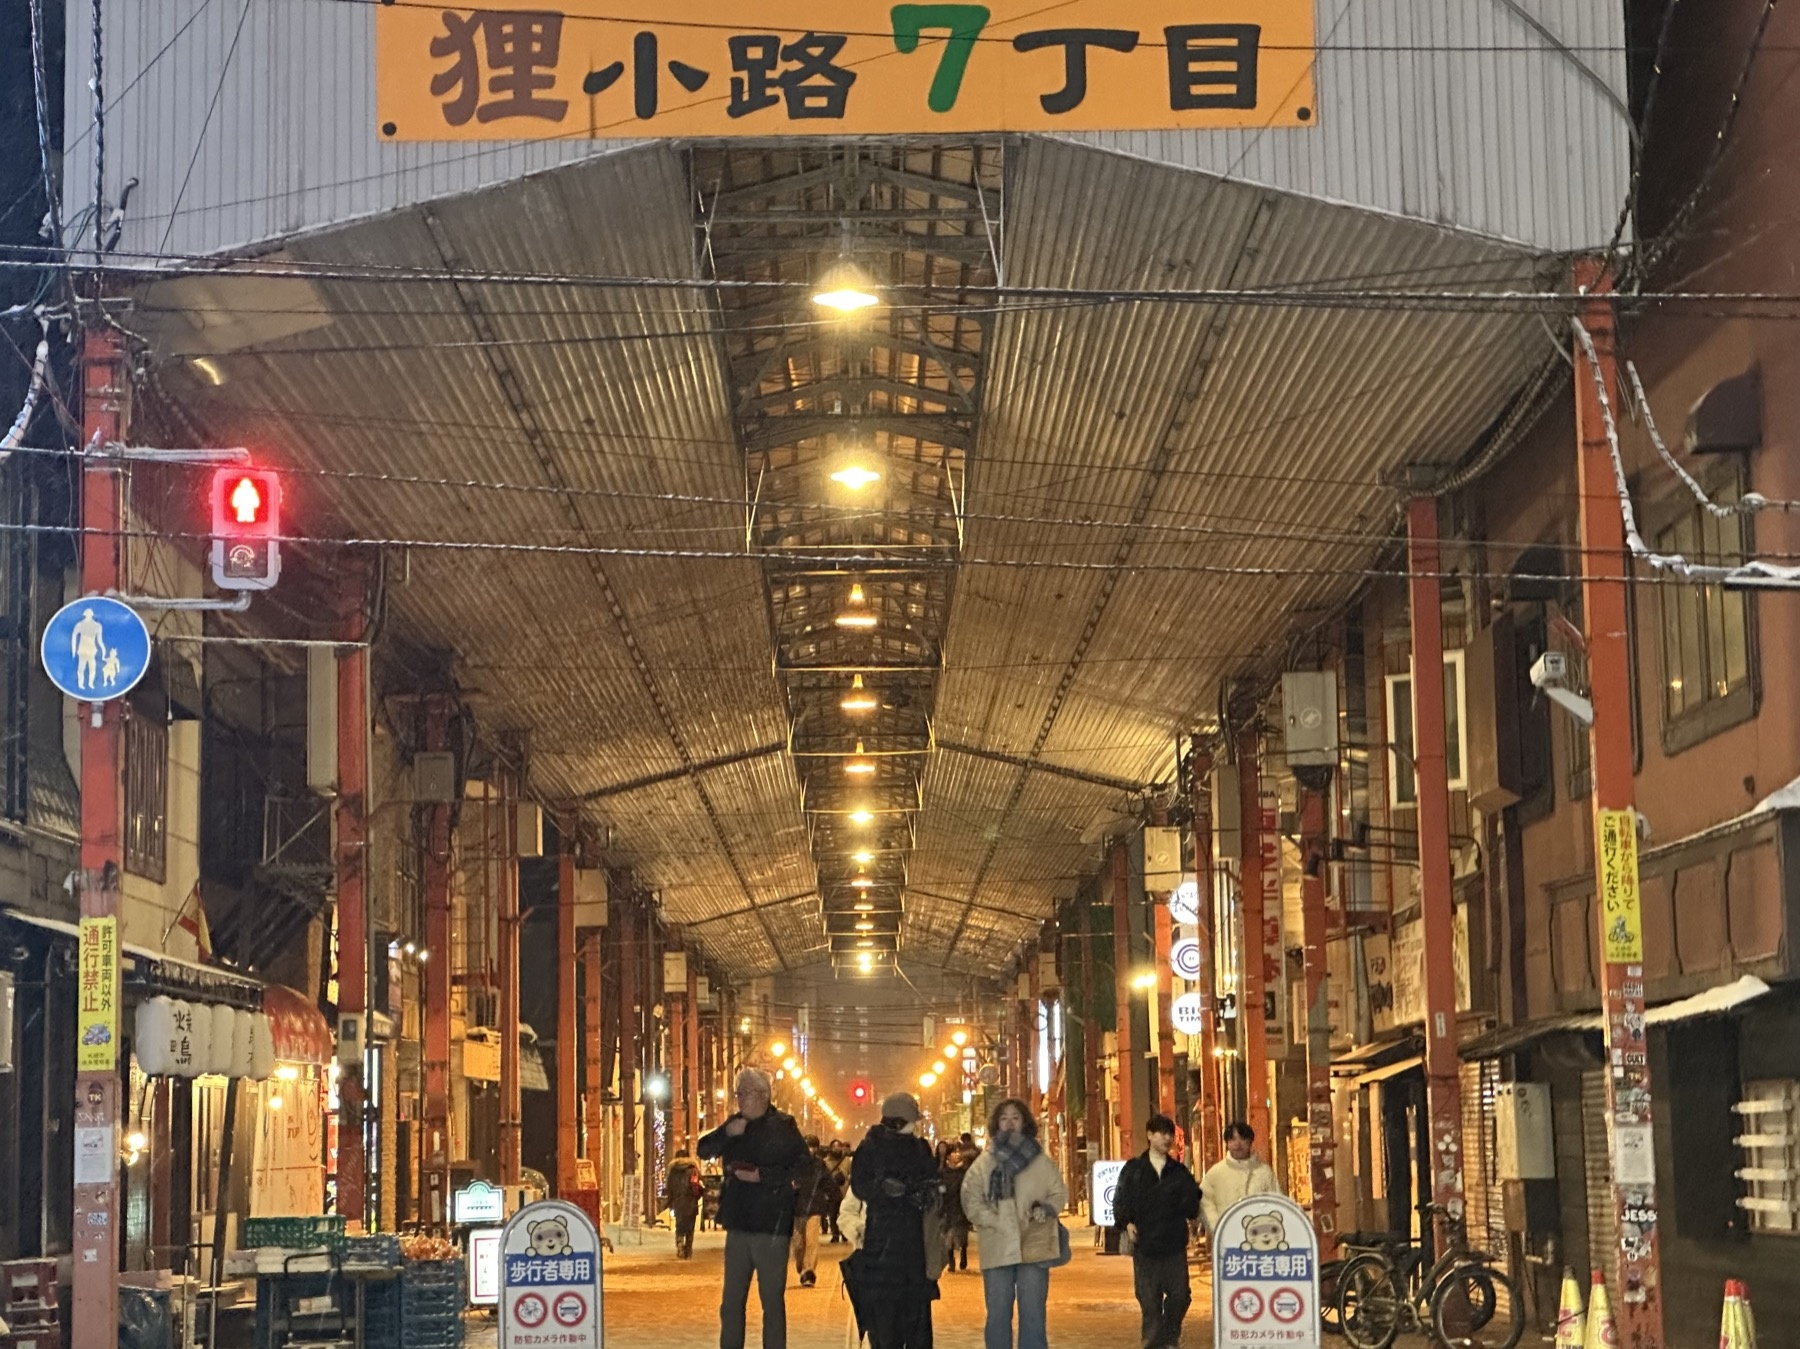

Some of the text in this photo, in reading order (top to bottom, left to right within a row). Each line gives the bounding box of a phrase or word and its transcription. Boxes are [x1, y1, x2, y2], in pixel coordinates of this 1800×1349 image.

[430, 4, 1261, 126] 狸小路7丁目
[1604, 816, 1620, 912] ご通行ください
[83, 925, 99, 1012] 通行禁止
[101, 925, 112, 1012] 許可車両以外
[89, 1093, 102, 1101] TK
[510, 1258, 591, 1283] 歩行者専用
[1225, 1254, 1308, 1278] 歩行者専用
[514, 1333, 587, 1345] 防犯カメラ作動中
[1230, 1329, 1305, 1340] 防犯カメラ作動中
